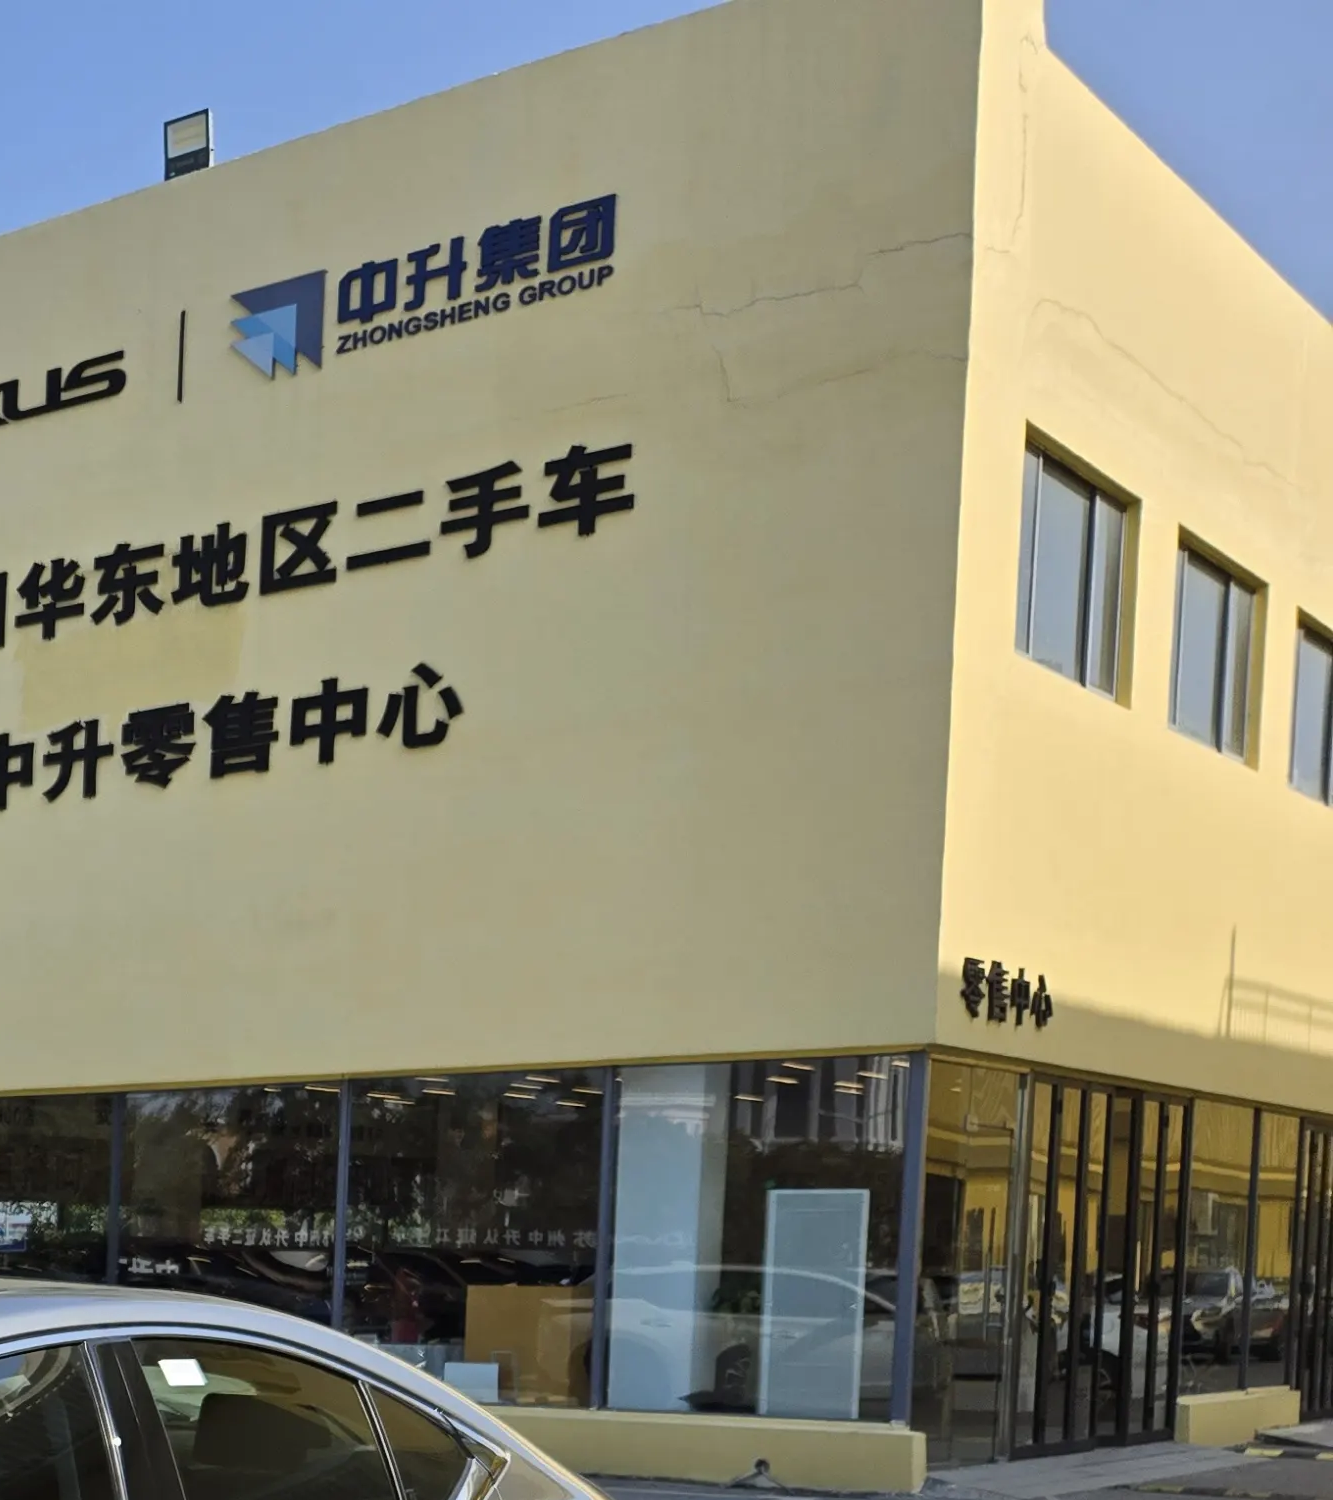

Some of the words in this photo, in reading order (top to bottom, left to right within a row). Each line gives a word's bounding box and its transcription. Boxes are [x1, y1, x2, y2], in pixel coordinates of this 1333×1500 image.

[337, 193, 617, 324] 中升集团
[336, 292, 510, 354] ZHONGSHENG
[519, 265, 614, 306] GROUP
[960, 957, 1053, 1028] 零售中心
